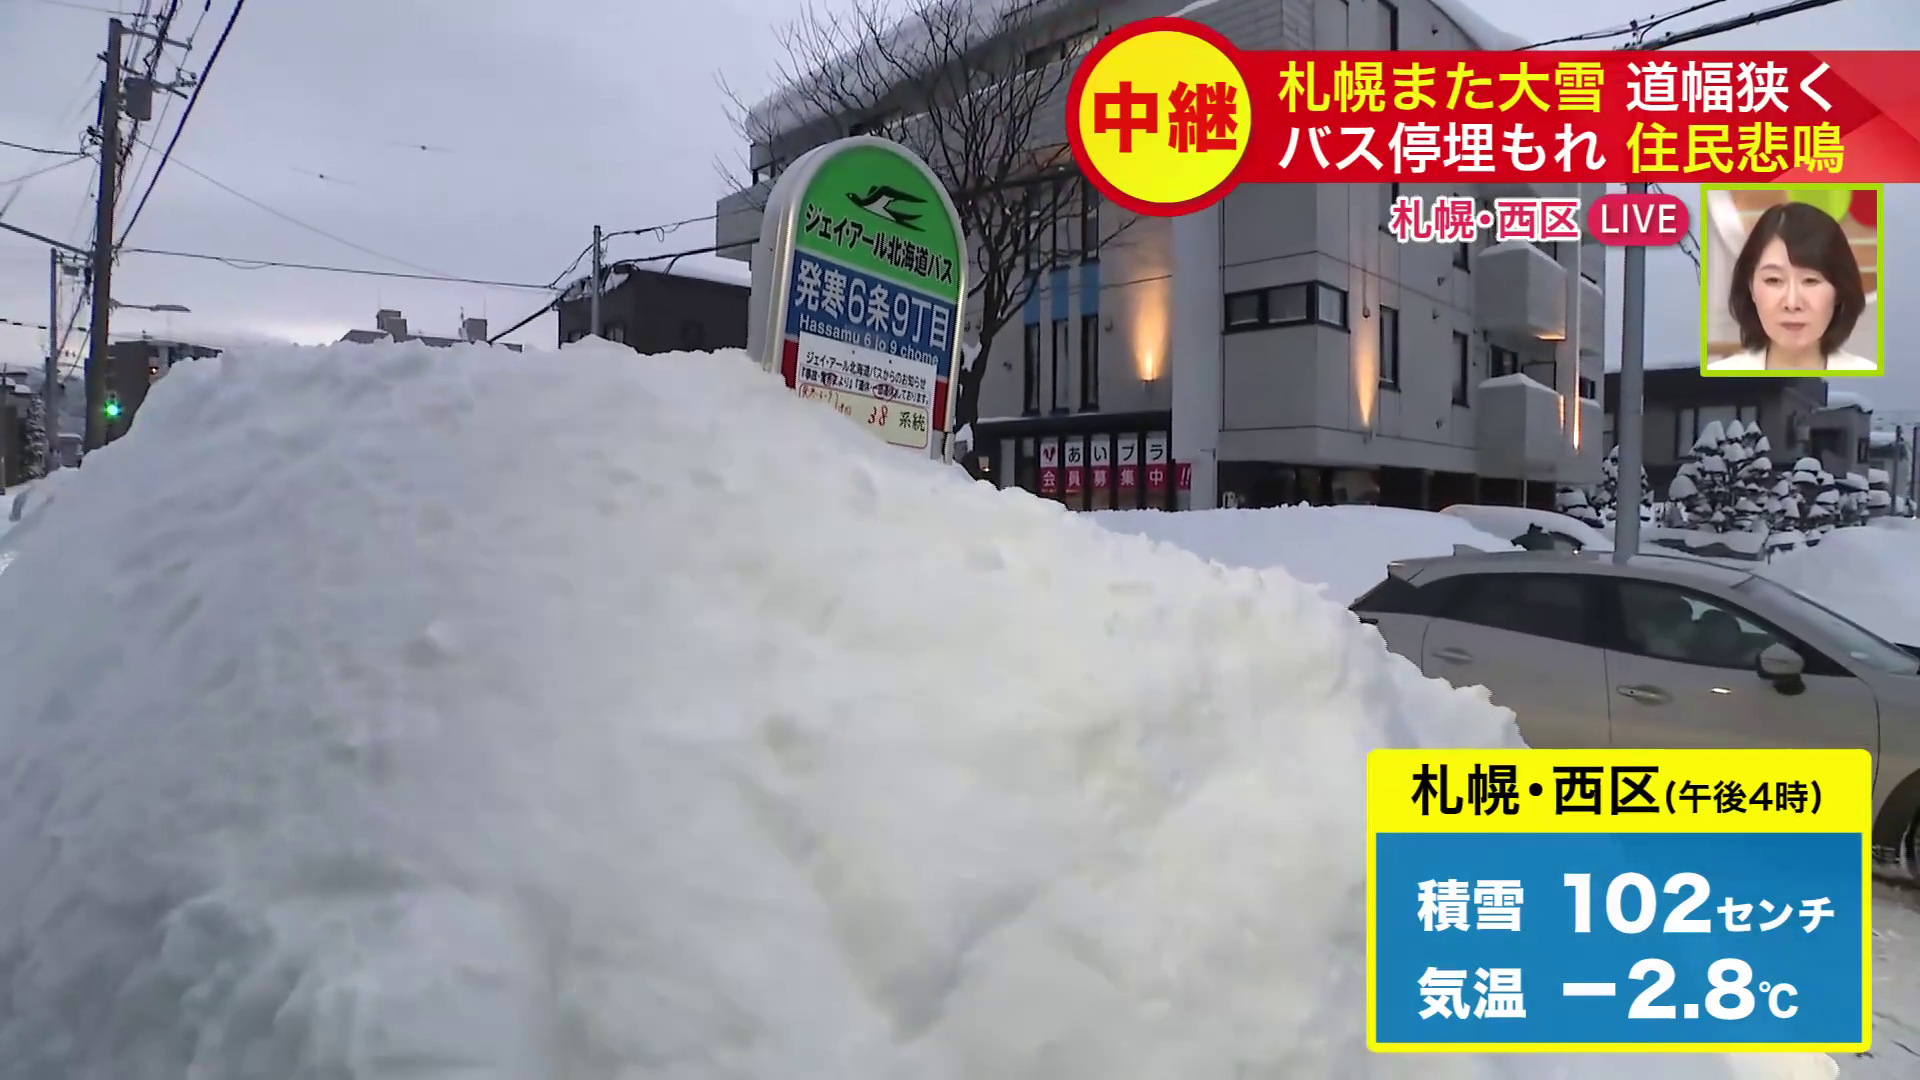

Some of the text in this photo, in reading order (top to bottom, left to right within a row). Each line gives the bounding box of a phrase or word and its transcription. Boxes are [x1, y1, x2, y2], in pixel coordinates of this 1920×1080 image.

[795, 259, 950, 351] 発寒6条9丁目
[800, 312, 860, 344] Hassamu
[863, 332, 871, 347] 6
[889, 339, 898, 355] 9
[900, 343, 940, 366] chome
[867, 405, 888, 426] 38
[899, 411, 925, 432] 系統
